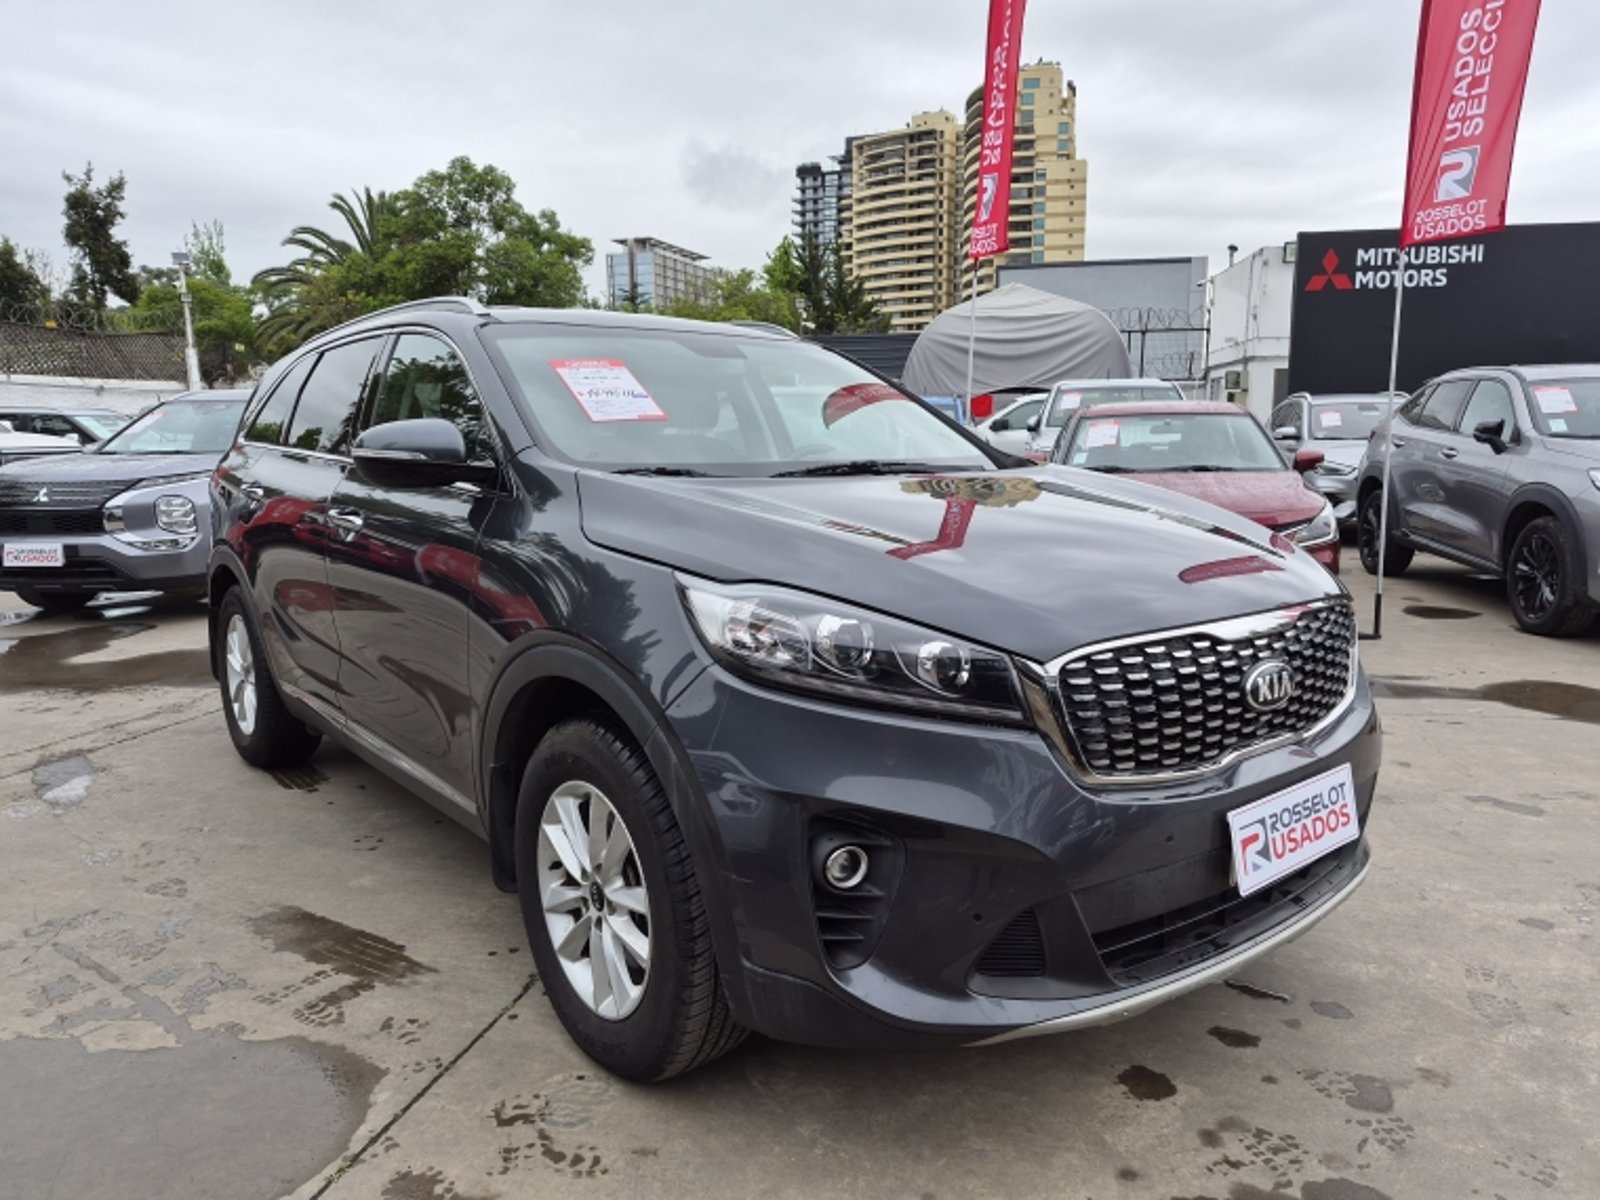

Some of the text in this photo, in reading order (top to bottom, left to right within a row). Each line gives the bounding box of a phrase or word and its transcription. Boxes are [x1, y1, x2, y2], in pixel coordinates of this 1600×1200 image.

[1444, 7, 1482, 143] USADOS
[1415, 199, 1488, 225] ROSSELOT
[1413, 214, 1487, 240] USADOS
[1356, 244, 1485, 267] MITSUBISHI
[1355, 268, 1448, 290] MOTORS
[1256, 670, 1292, 702] KIA
[1269, 781, 1347, 835] ROSSELOT
[1271, 802, 1351, 861] USADOS
